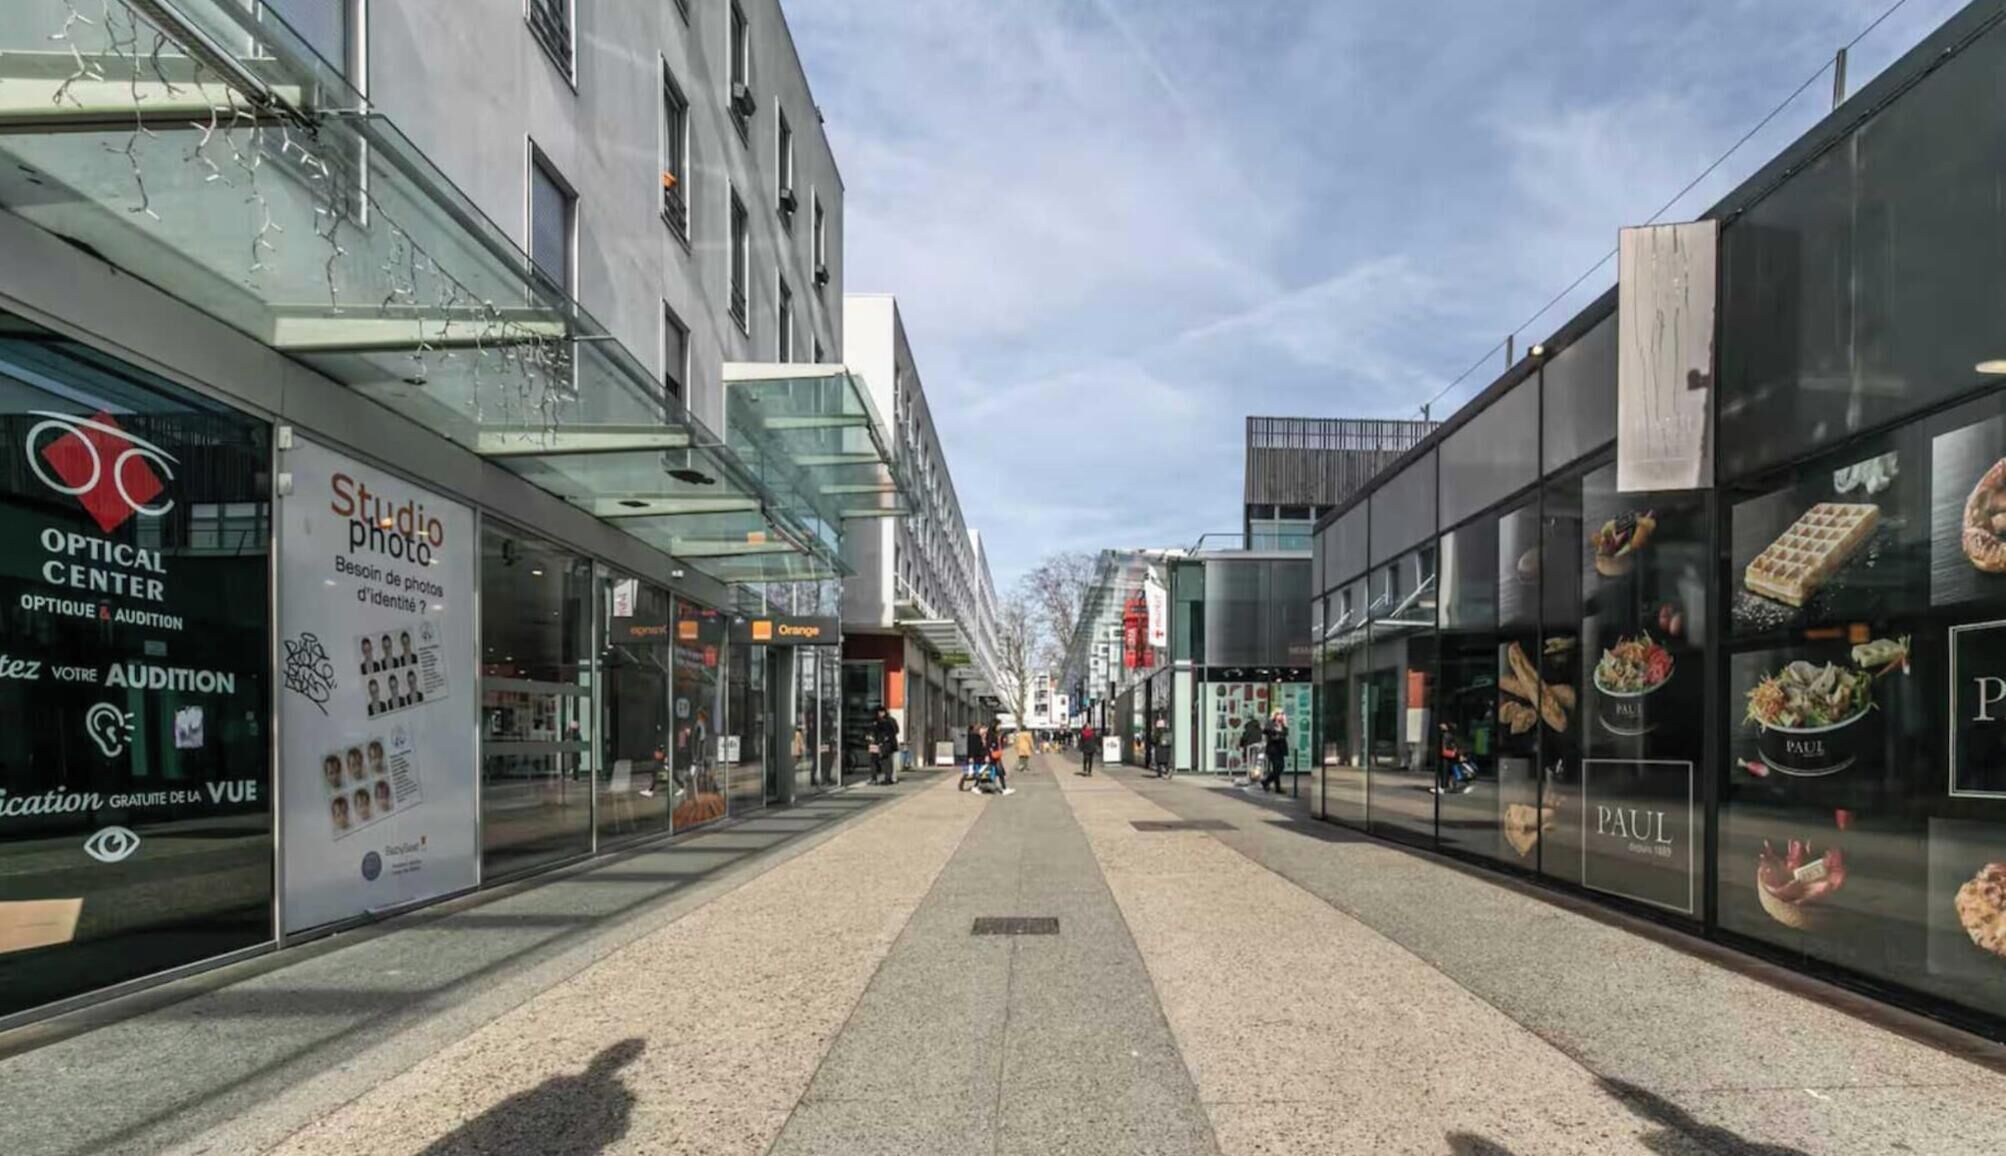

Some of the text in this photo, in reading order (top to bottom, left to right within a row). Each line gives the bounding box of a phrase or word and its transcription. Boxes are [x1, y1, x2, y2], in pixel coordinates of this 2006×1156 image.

[330, 472, 443, 548] Studio
[40, 527, 167, 574] OPTICAL
[349, 516, 432, 567] photo
[42, 560, 165, 601] CENTER
[335, 554, 444, 598] Besoin de photos
[20, 593, 184, 631] OPTIQUE & AUDITION
[357, 587, 427, 615] d'identité ?
[778, 623, 820, 638] Orange
[51, 665, 99, 683] VOTRE
[105, 662, 236, 695] AUDITION
[1786, 740, 1825, 754] PAUL
[109, 791, 168, 809] GRATUITE
[169, 790, 187, 805] DE
[187, 789, 202, 804] LA
[206, 779, 258, 804] VUE
[1597, 805, 1673, 844] PAUL
